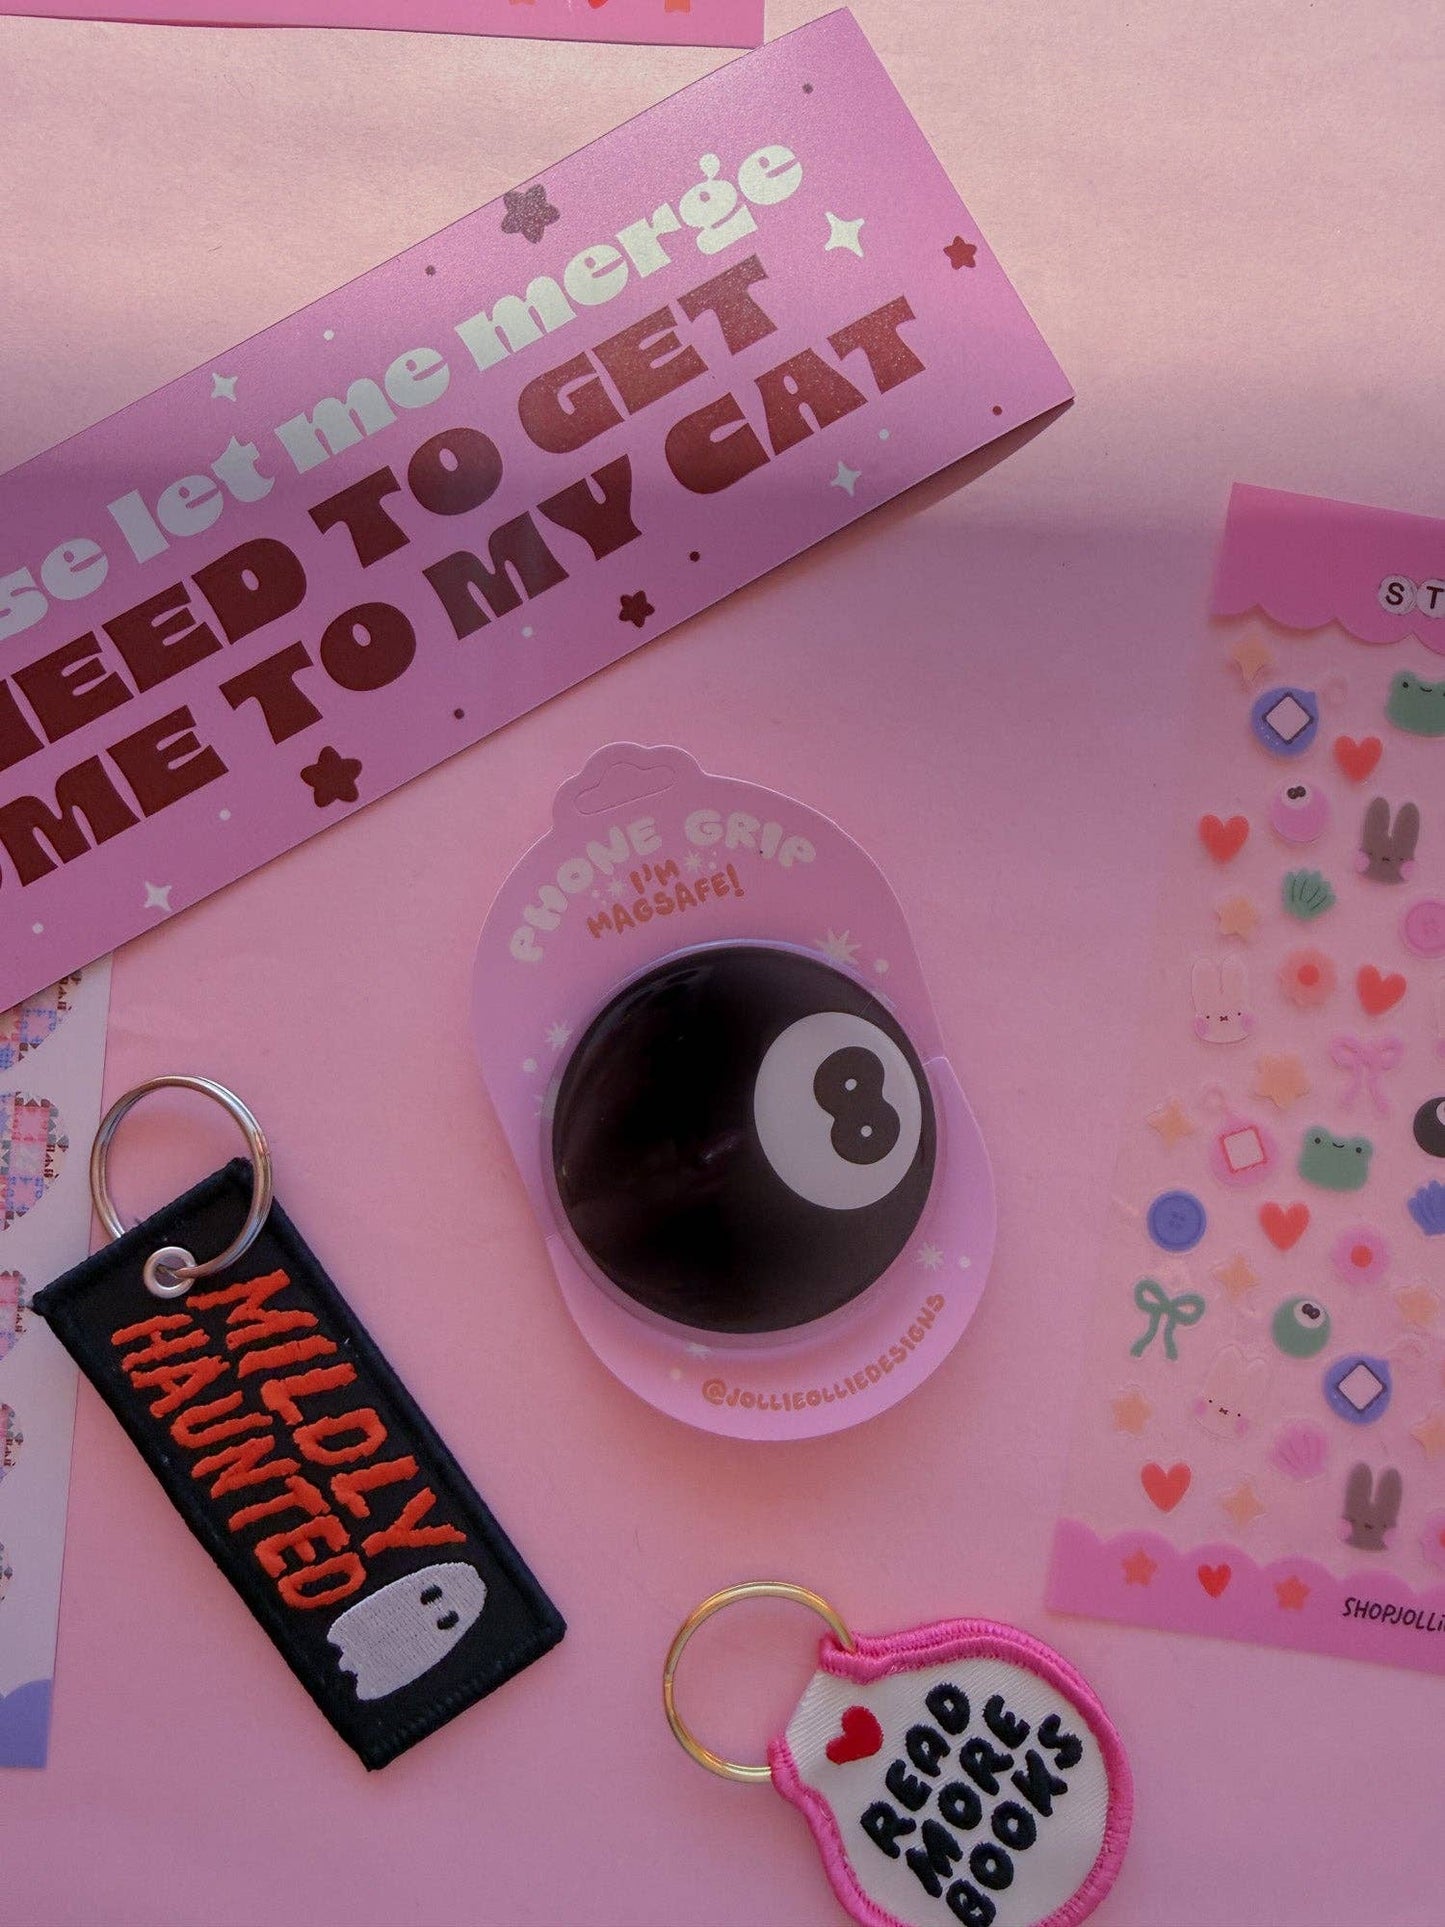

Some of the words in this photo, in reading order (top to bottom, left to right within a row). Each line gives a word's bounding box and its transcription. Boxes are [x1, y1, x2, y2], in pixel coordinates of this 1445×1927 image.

[107, 435, 275, 565] let
[274, 344, 450, 474] me
[454, 144, 803, 372] merge
[308, 427, 503, 570] TO
[518, 254, 778, 454] GET
[0, 704, 230, 888] ME
[218, 601, 417, 745] TO
[421, 453, 643, 641] MY
[664, 295, 926, 495] CAT
[509, 816, 663, 963] PHONE
[684, 809, 817, 869] GRIP
[585, 863, 746, 938] MAGSAFE!
[628, 858, 681, 896] I'M
[813, 1046, 901, 1165] 8
[185, 1268, 467, 1559] MILDLY
[702, 1293, 946, 1412] @JOLLIEOLLIEDESIGNS
[111, 1312, 366, 1610] HAUNTED
[860, 1682, 970, 1860] READ
[905, 1694, 1031, 1899] MORE
[946, 1713, 1083, 1927] BOOKS
